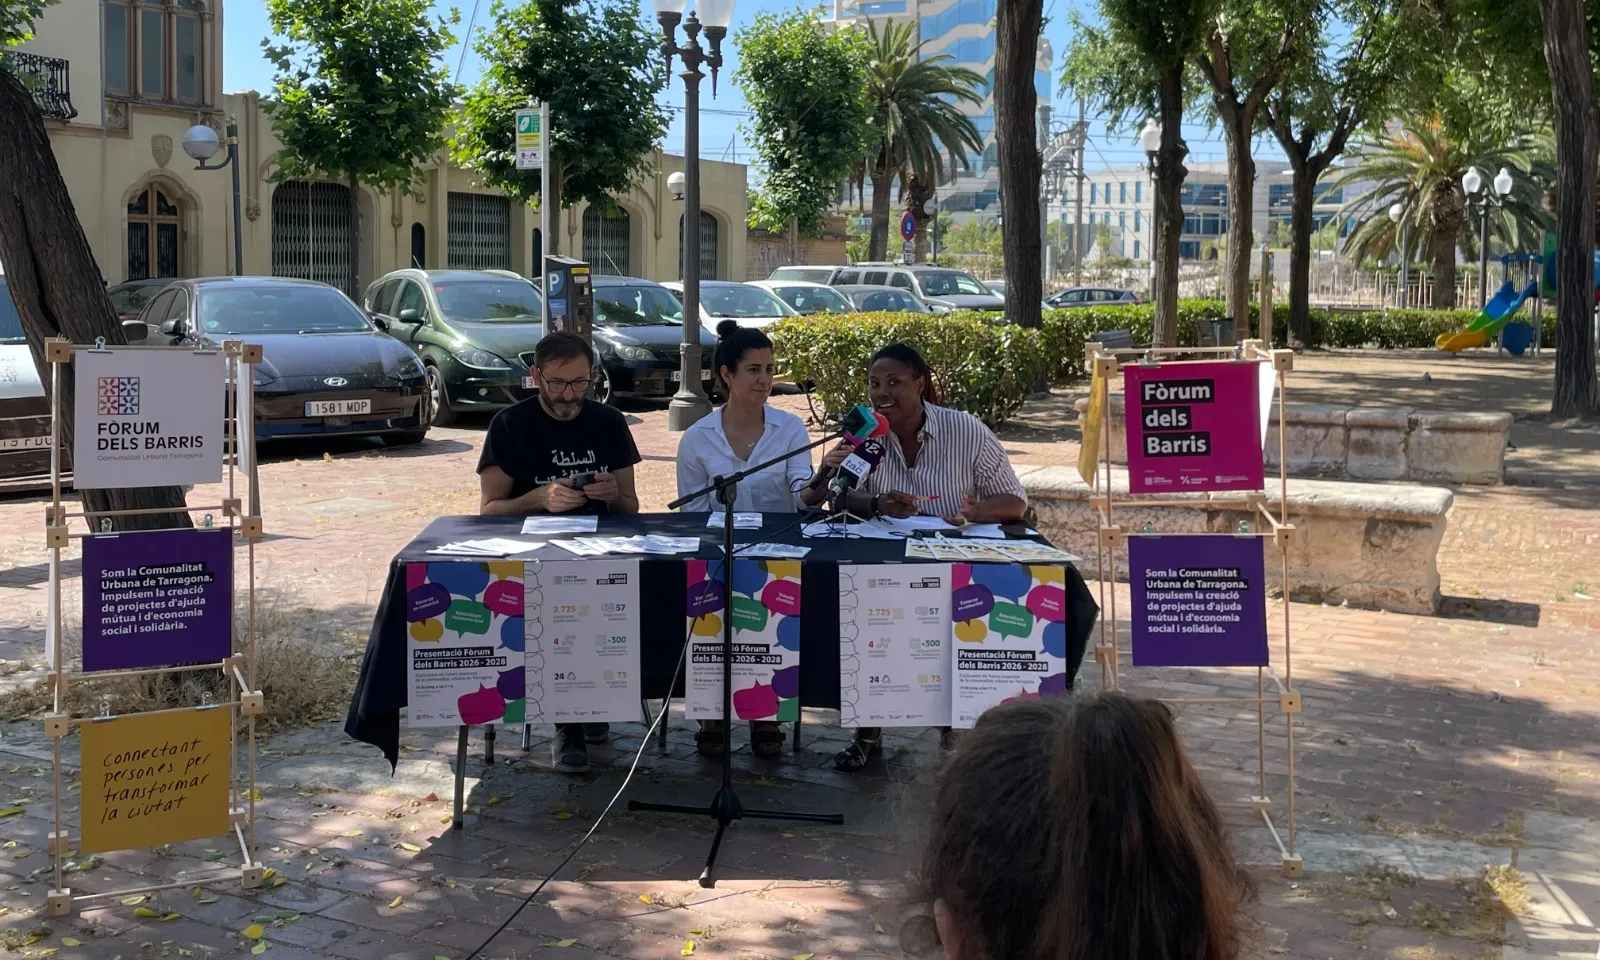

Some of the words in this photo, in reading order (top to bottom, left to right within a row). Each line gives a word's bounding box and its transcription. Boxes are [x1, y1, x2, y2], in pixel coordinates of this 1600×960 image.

[550, 274, 559, 292] P
[1144, 382, 1210, 400] Fòrum
[316, 403, 342, 414] 1581
[346, 402, 368, 412] MDP
[1145, 409, 1188, 427] dels
[98, 420, 160, 435] FÒRUM
[97, 437, 138, 450] DELS
[145, 435, 203, 449] BARRIS
[1147, 435, 1207, 454] Barris
[552, 450, 596, 466] السلطة
[102, 570, 124, 578] Som
[128, 568, 136, 576] la
[139, 563, 202, 576] Comunalitat
[1146, 569, 1166, 577] Som
[1168, 569, 1177, 577] la
[1179, 569, 1237, 577] Comunalitat
[102, 580, 140, 590] Urbana
[142, 578, 156, 587] de
[158, 574, 213, 586] Tarragona.
[1146, 580, 1181, 588] Urbana
[1183, 580, 1195, 588] de
[1196, 580, 1247, 590] Tarragona.
[102, 590, 153, 602] Impulsem
[156, 589, 165, 597] la
[167, 585, 204, 596] creació
[1147, 591, 1193, 601] Impulsem
[1195, 591, 1203, 599] la
[1206, 591, 1239, 599] creació
[102, 604, 115, 613] de
[117, 601, 166, 613] projectes
[168, 597, 206, 608] d'ajuda
[1147, 602, 1159, 610] de
[1161, 602, 1205, 612] projectes
[1206, 602, 1242, 612] d'ajuda
[102, 612, 136, 624] mútua
[139, 613, 141, 621] i
[144, 608, 203, 621] d'economia
[1148, 613, 1178, 622] mútua
[1180, 613, 1183, 621] i
[1185, 613, 1240, 622] d'economia
[102, 626, 132, 636] social
[140, 621, 187, 632] solidària.
[1148, 624, 1174, 632] social
[1182, 624, 1226, 633] solidària.
[415, 648, 462, 658] Presentació
[464, 648, 490, 656] Fòrum
[415, 660, 431, 669] dels
[434, 659, 457, 668] Barris
[103, 738, 201, 767] Connectant
[104, 763, 173, 787] persones
[185, 753, 211, 775] per
[104, 774, 210, 804] transformar
[101, 807, 118, 824] la
[128, 794, 186, 818] ciutat
